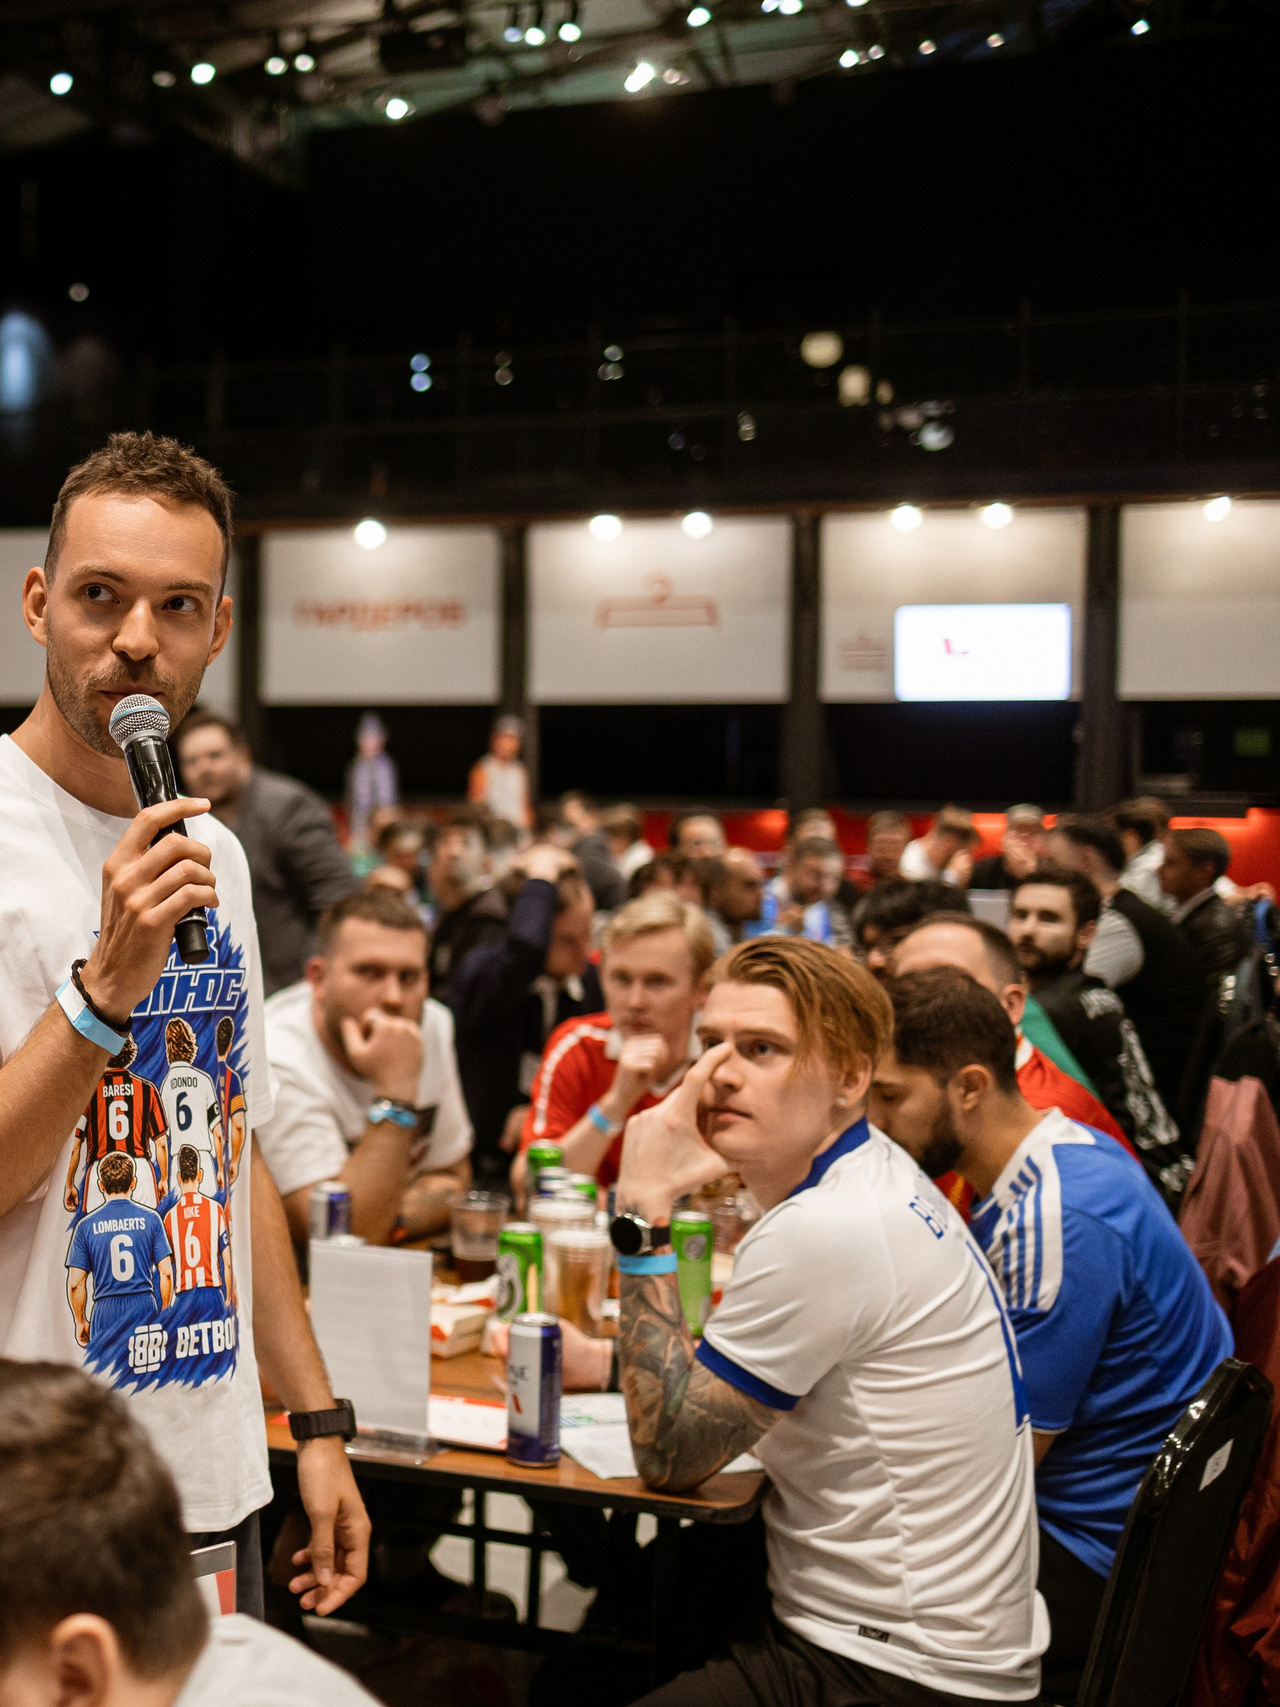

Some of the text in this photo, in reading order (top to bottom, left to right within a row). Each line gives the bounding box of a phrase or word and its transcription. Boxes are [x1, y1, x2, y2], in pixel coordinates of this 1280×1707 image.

[130, 968, 246, 1018] ЛЮС
[102, 1083, 134, 1098] BARESI
[108, 1100, 130, 1140] 6
[176, 1091, 192, 1131] 6
[93, 1217, 146, 1234] LOMBAERTS
[185, 1221, 201, 1268] 6
[110, 1234, 135, 1282] 6
